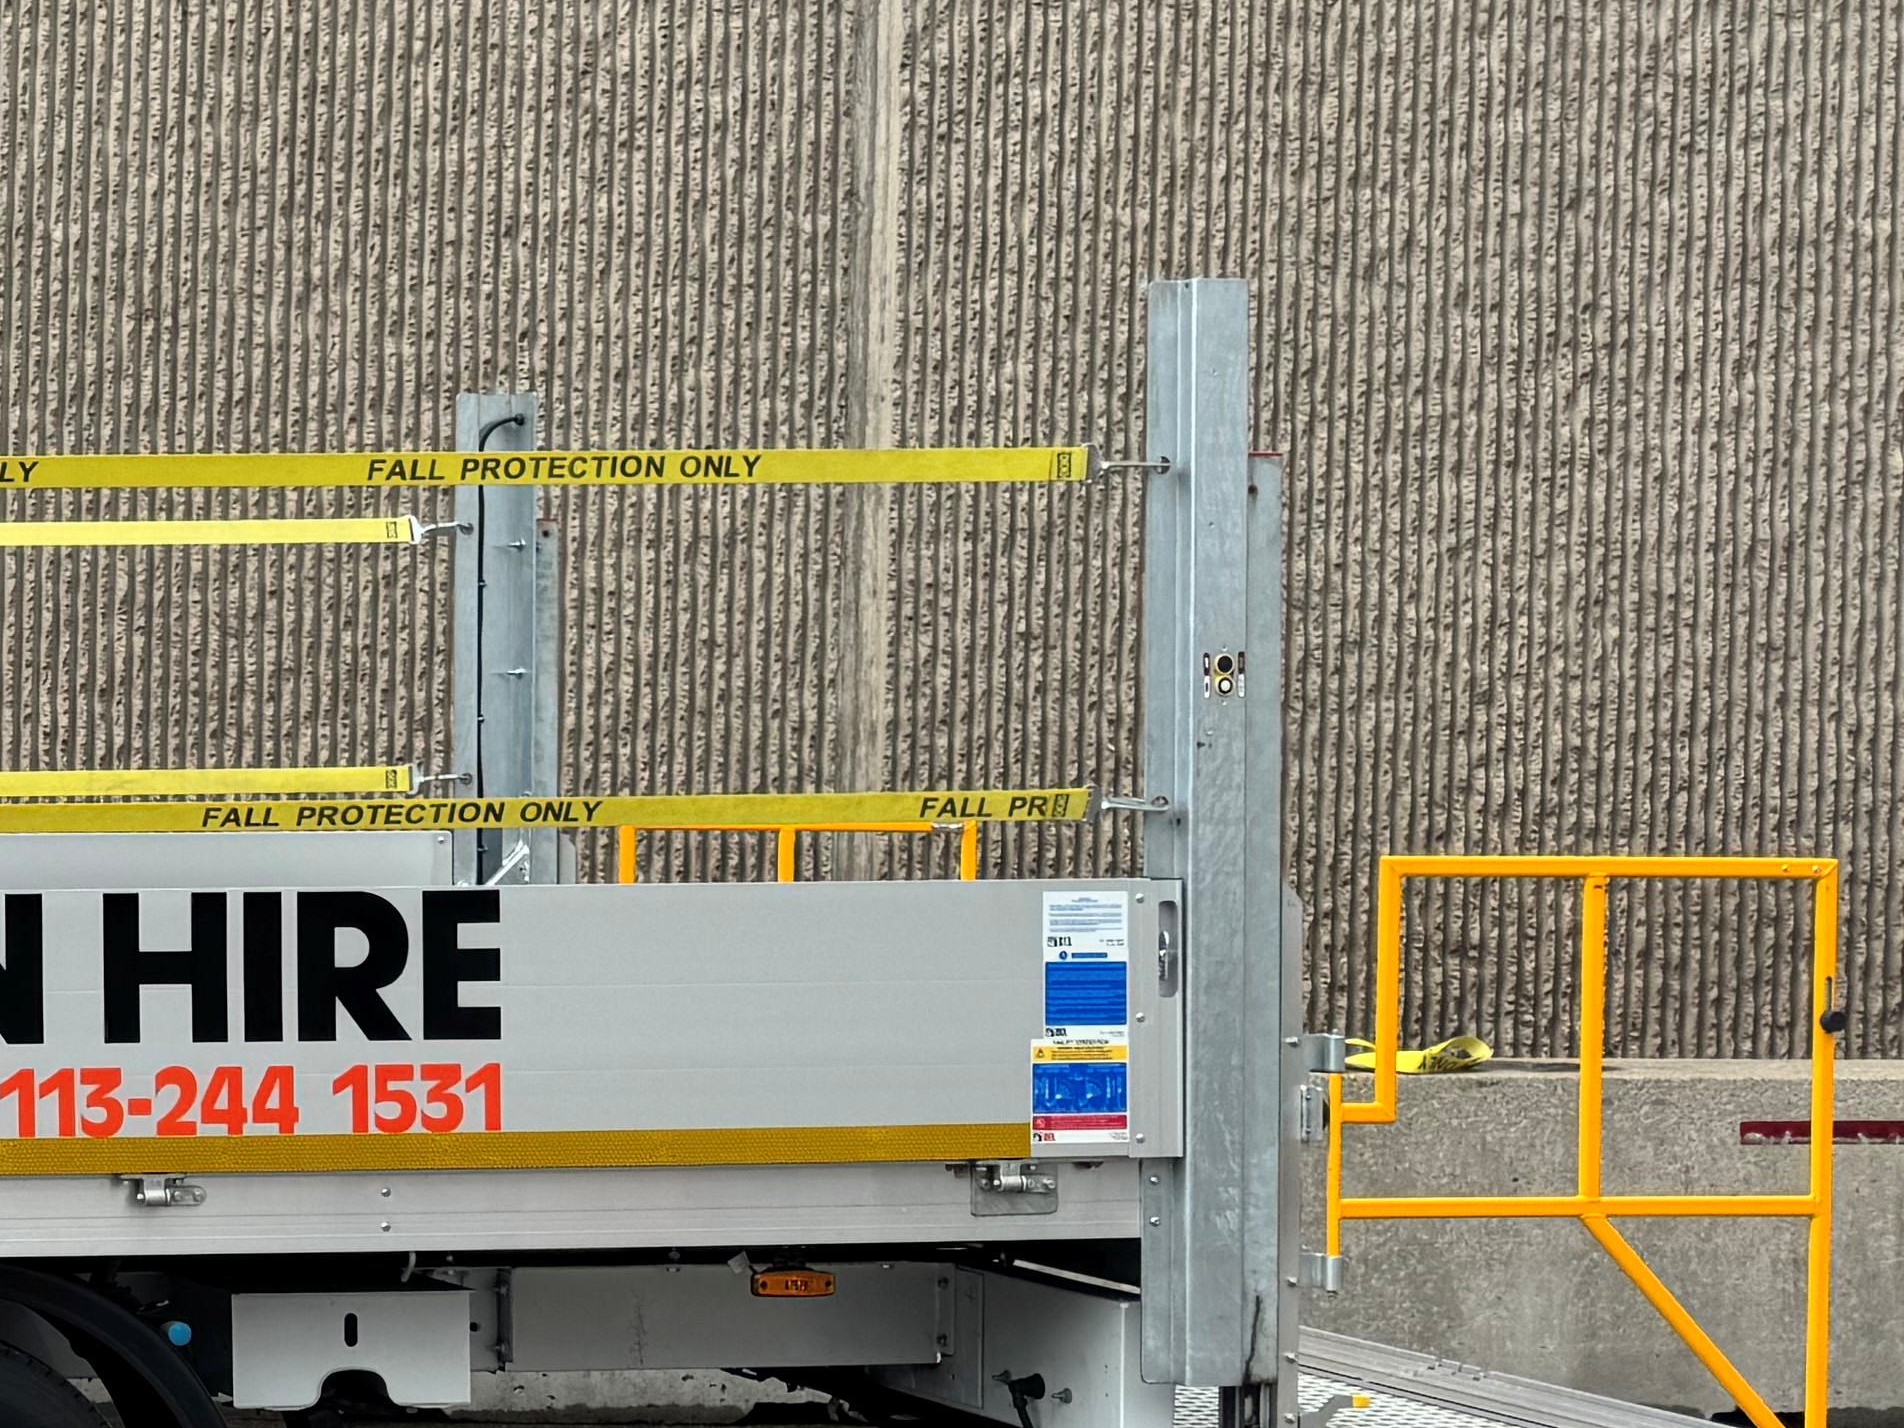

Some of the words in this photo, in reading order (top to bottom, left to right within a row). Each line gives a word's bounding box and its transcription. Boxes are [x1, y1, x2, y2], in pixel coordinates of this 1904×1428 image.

[367, 459, 445, 481] FALL
[460, 455, 666, 481] PROTECTION
[680, 455, 761, 478] ONLY
[202, 807, 280, 828] FALL
[296, 802, 505, 827] PROTECTION
[519, 800, 603, 823] ONLY
[919, 797, 992, 818] FALL
[102, 889, 502, 1044] HIRE
[332, 1062, 502, 1135] 1531
